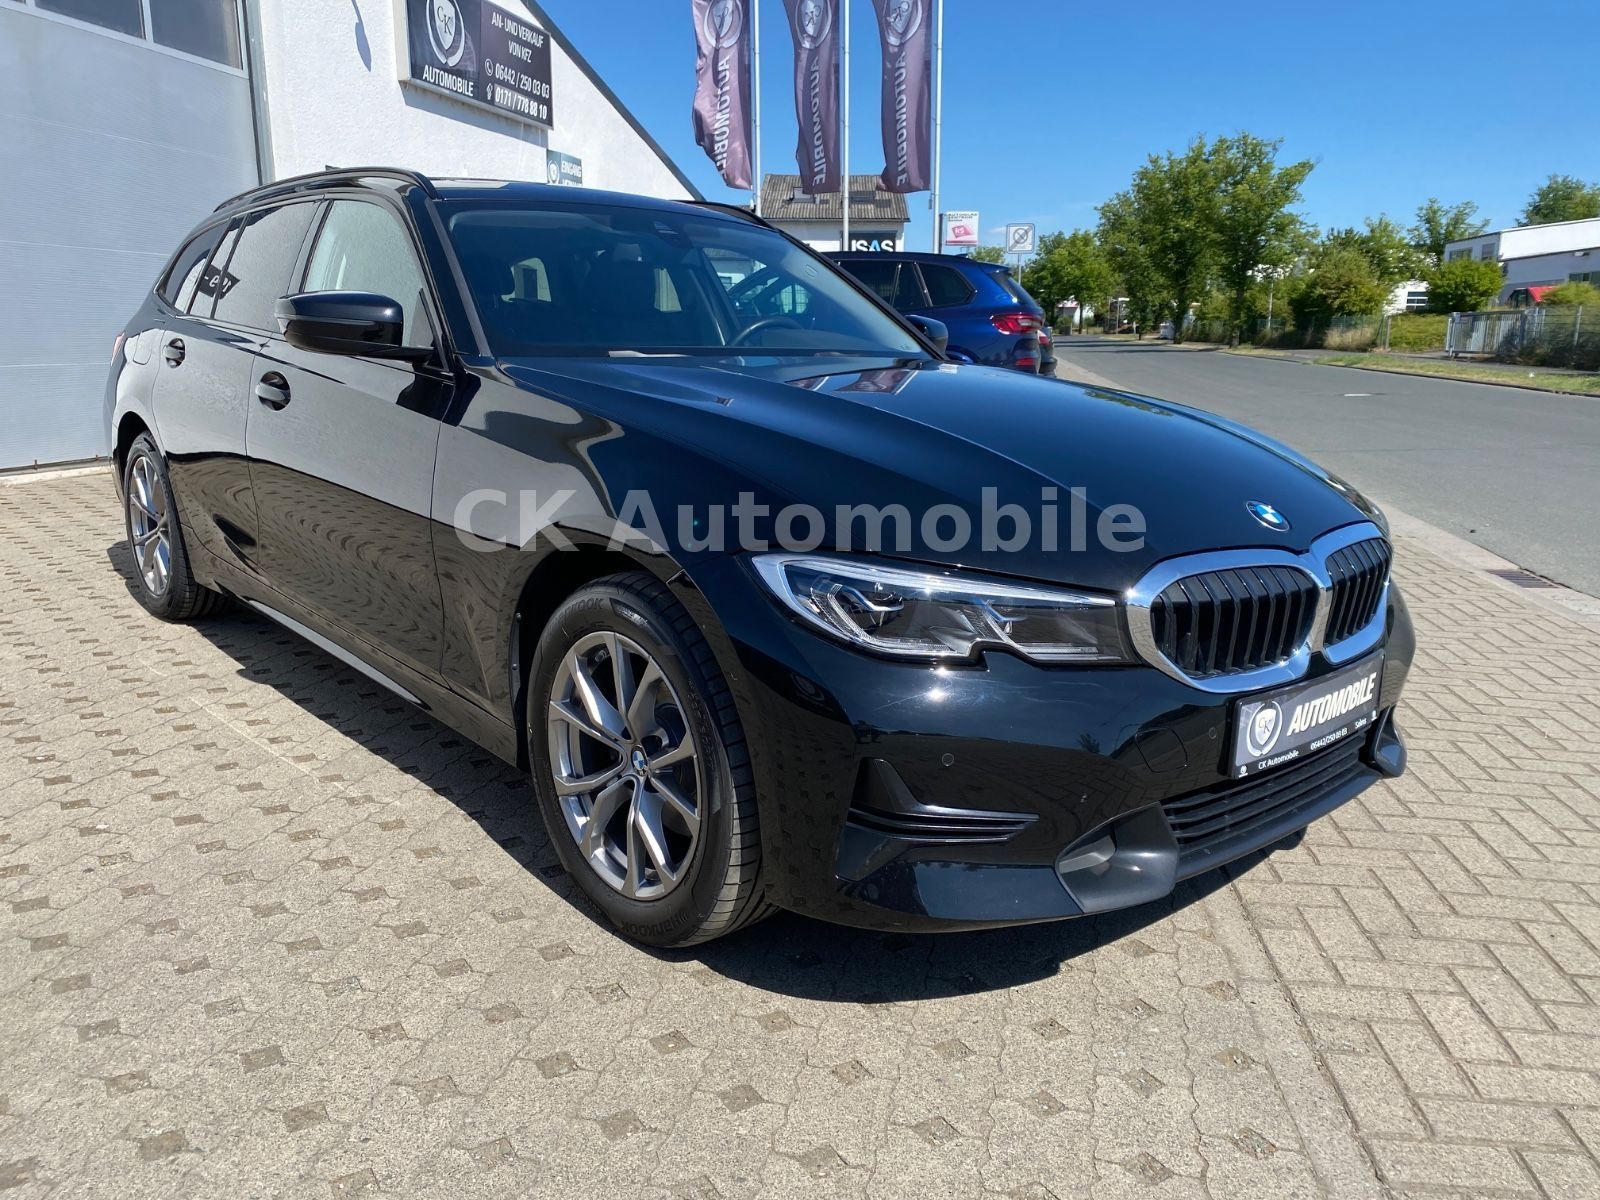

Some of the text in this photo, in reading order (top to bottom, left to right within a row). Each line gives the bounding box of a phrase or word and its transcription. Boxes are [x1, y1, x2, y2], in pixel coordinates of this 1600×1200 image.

[437, 6, 452, 36] CK
[491, 11, 544, 48] AN- UND VERKAUF
[508, 39, 532, 63] VON KFZ
[422, 64, 474, 97] AUTOMOBILE
[495, 63, 516, 85] 06442
[520, 73, 532, 92] 250
[532, 78, 541, 96] 03
[541, 82, 550, 99] 03
[495, 86, 512, 107] 0171
[517, 95, 529, 114] 778
[529, 100, 538, 117] 88
[539, 103, 548, 120] 10
[1286, 672, 1377, 736] AUTOMOBILE
[1267, 749, 1299, 767] Automobile
